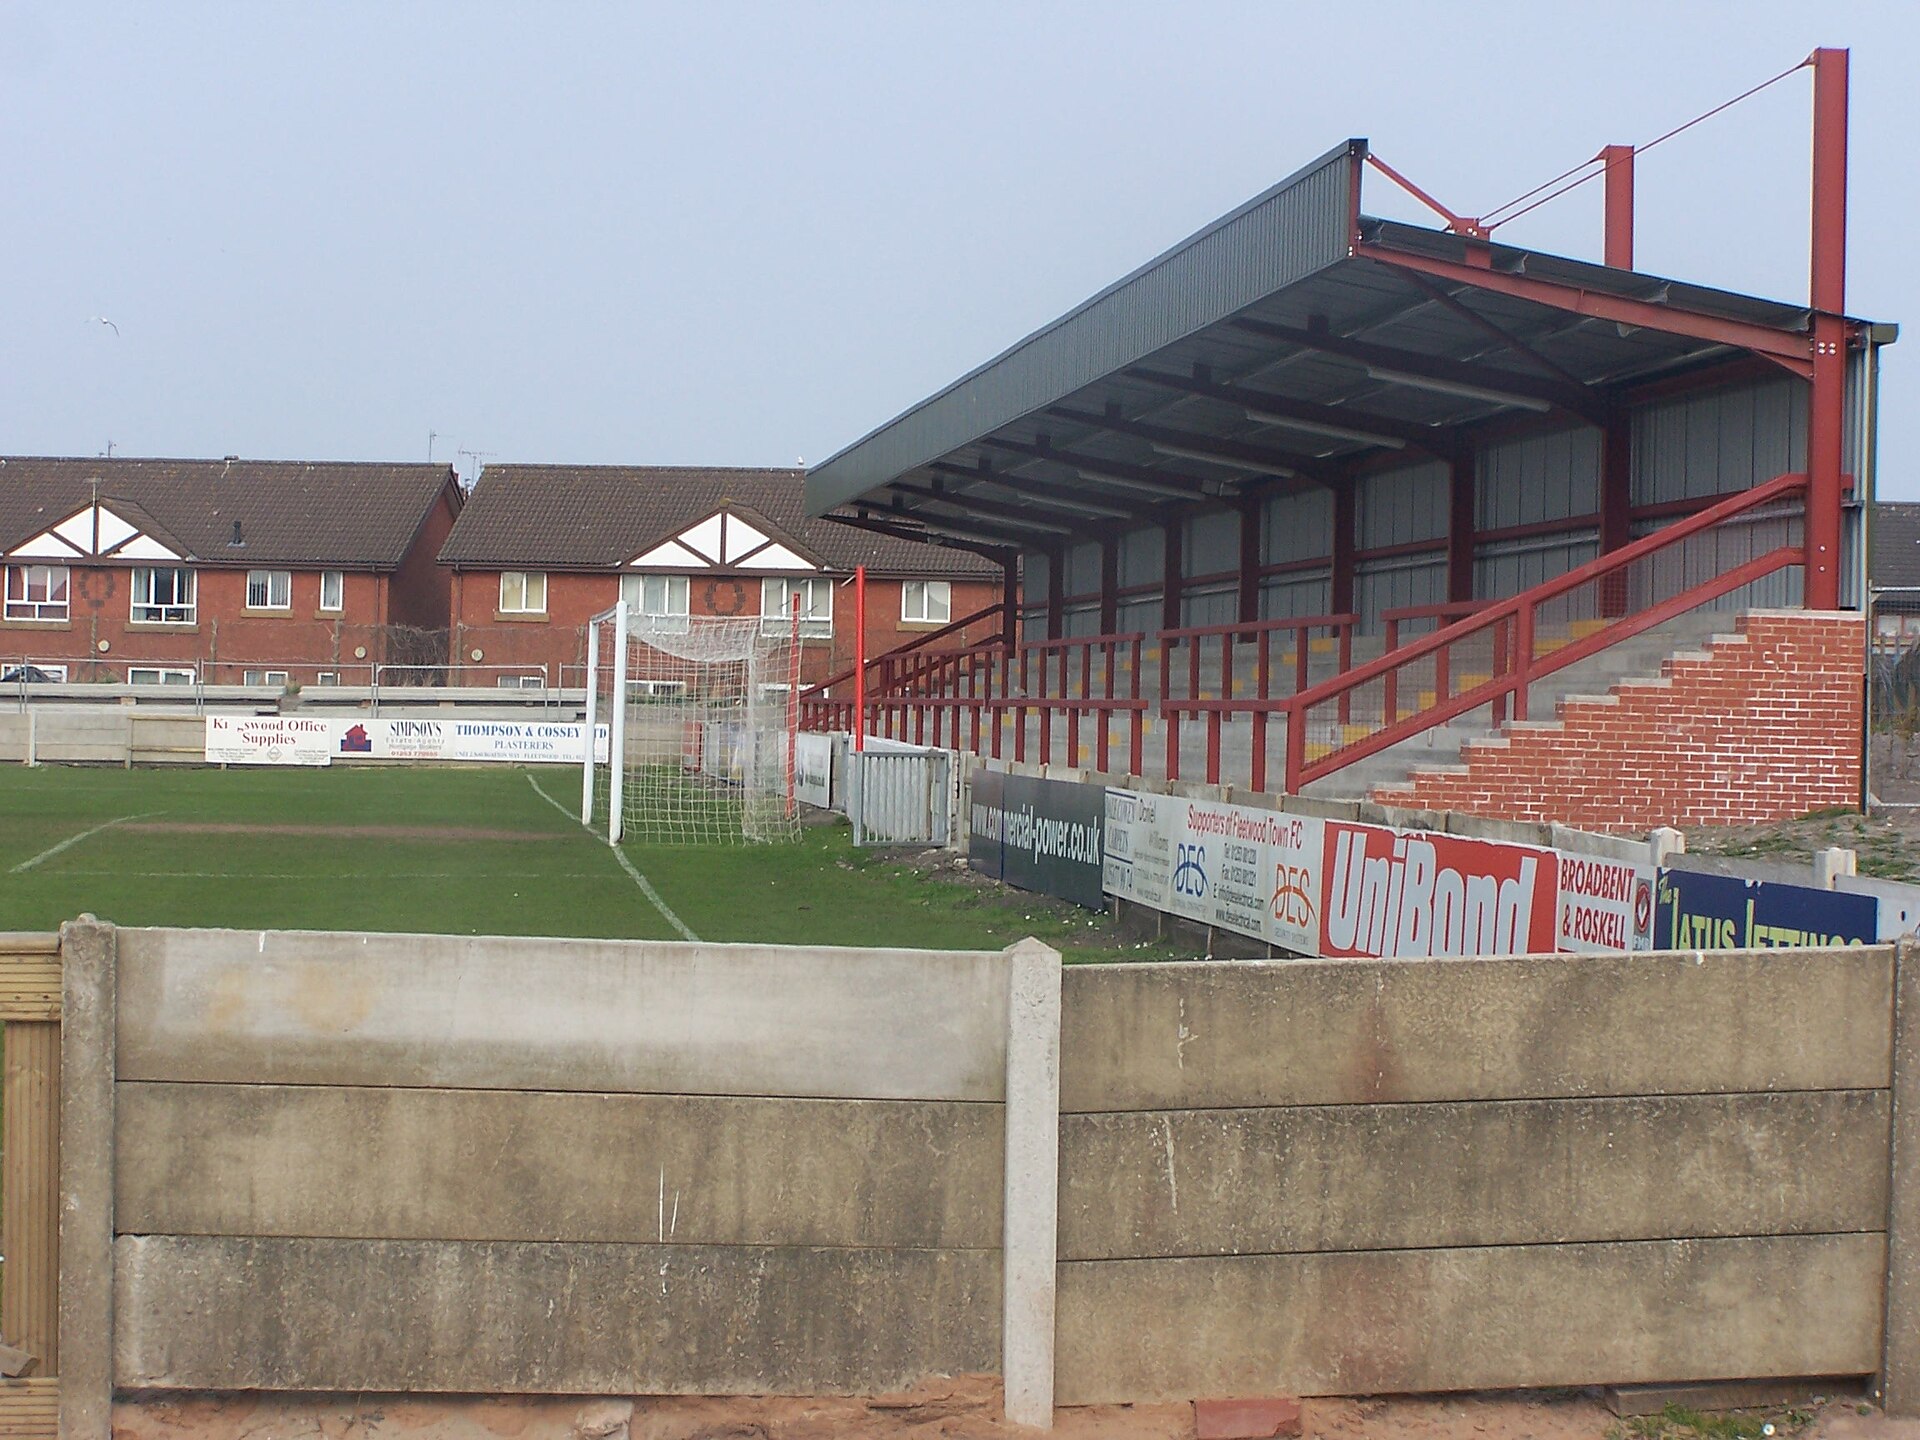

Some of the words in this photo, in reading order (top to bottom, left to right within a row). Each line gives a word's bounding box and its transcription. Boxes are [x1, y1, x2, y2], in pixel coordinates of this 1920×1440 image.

[213, 718, 283, 732] Kiswood
[288, 720, 327, 732] Office
[242, 732, 297, 747] Supplies
[390, 721, 442, 737] SIMPSON'S
[456, 724, 522, 737] THOMPSON
[525, 725, 533, 737] &
[537, 727, 581, 738] COSSEY
[494, 740, 554, 750] PLASTERERS
[1188, 804, 1225, 838] Supporters
[1226, 811, 1234, 836] of
[1233, 811, 1267, 843] Fleetwood
[1268, 817, 1288, 847] Town
[1290, 820, 1303, 850] FC
[1177, 843, 1206, 897] DES
[1560, 858, 1635, 903] BROADBENT
[1275, 863, 1310, 928] DES
[1329, 829, 1538, 958] UniBond
[1562, 904, 1571, 937] &
[1574, 906, 1626, 950] ROSKELL
